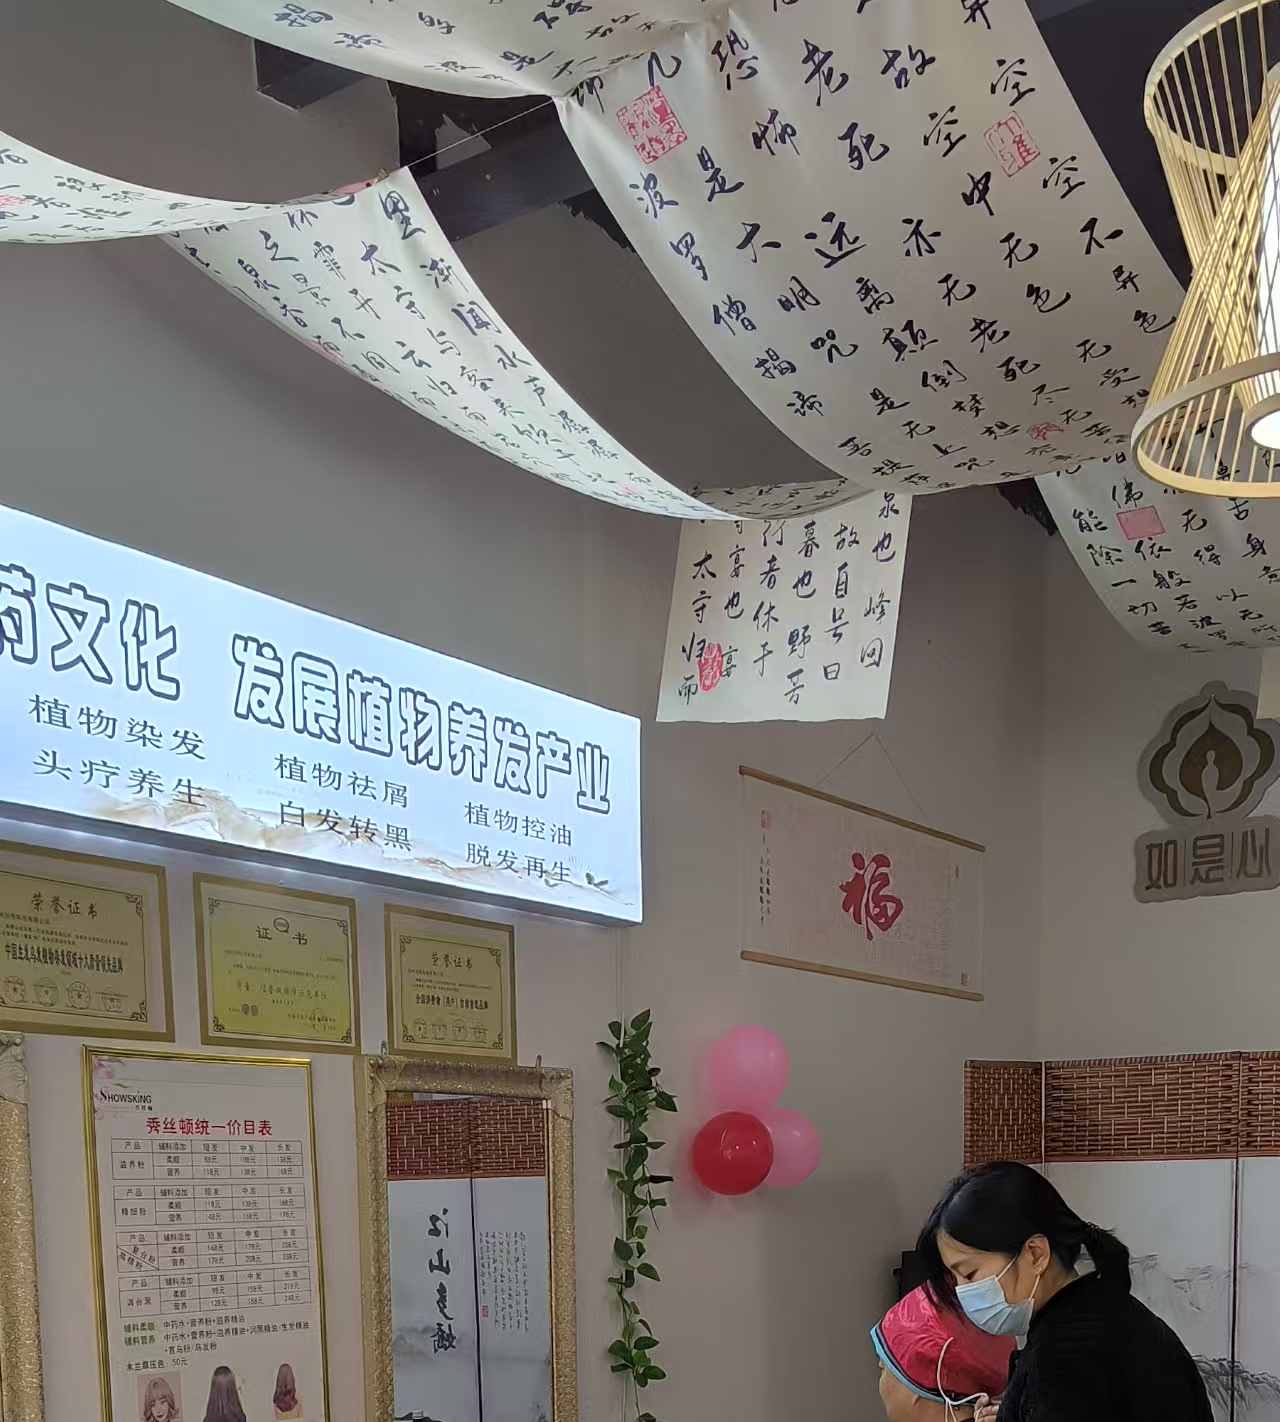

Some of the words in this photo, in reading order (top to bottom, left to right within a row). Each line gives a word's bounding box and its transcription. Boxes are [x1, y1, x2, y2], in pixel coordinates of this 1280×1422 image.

[28, 693, 207, 761] 植物染发
[232, 634, 612, 815] 发展植物养发产业
[32, 749, 207, 809] 头疗养生
[274, 752, 410, 810] 植物祛屑
[278, 801, 413, 853] 白发转黑
[463, 801, 574, 848] 植物控油
[465, 841, 572, 884] 脱发再生
[31, 892, 98, 919] 荣誉证书
[839, 852, 903, 941] 福
[146, 1117, 273, 1136] 秀丝顿统一价目表
